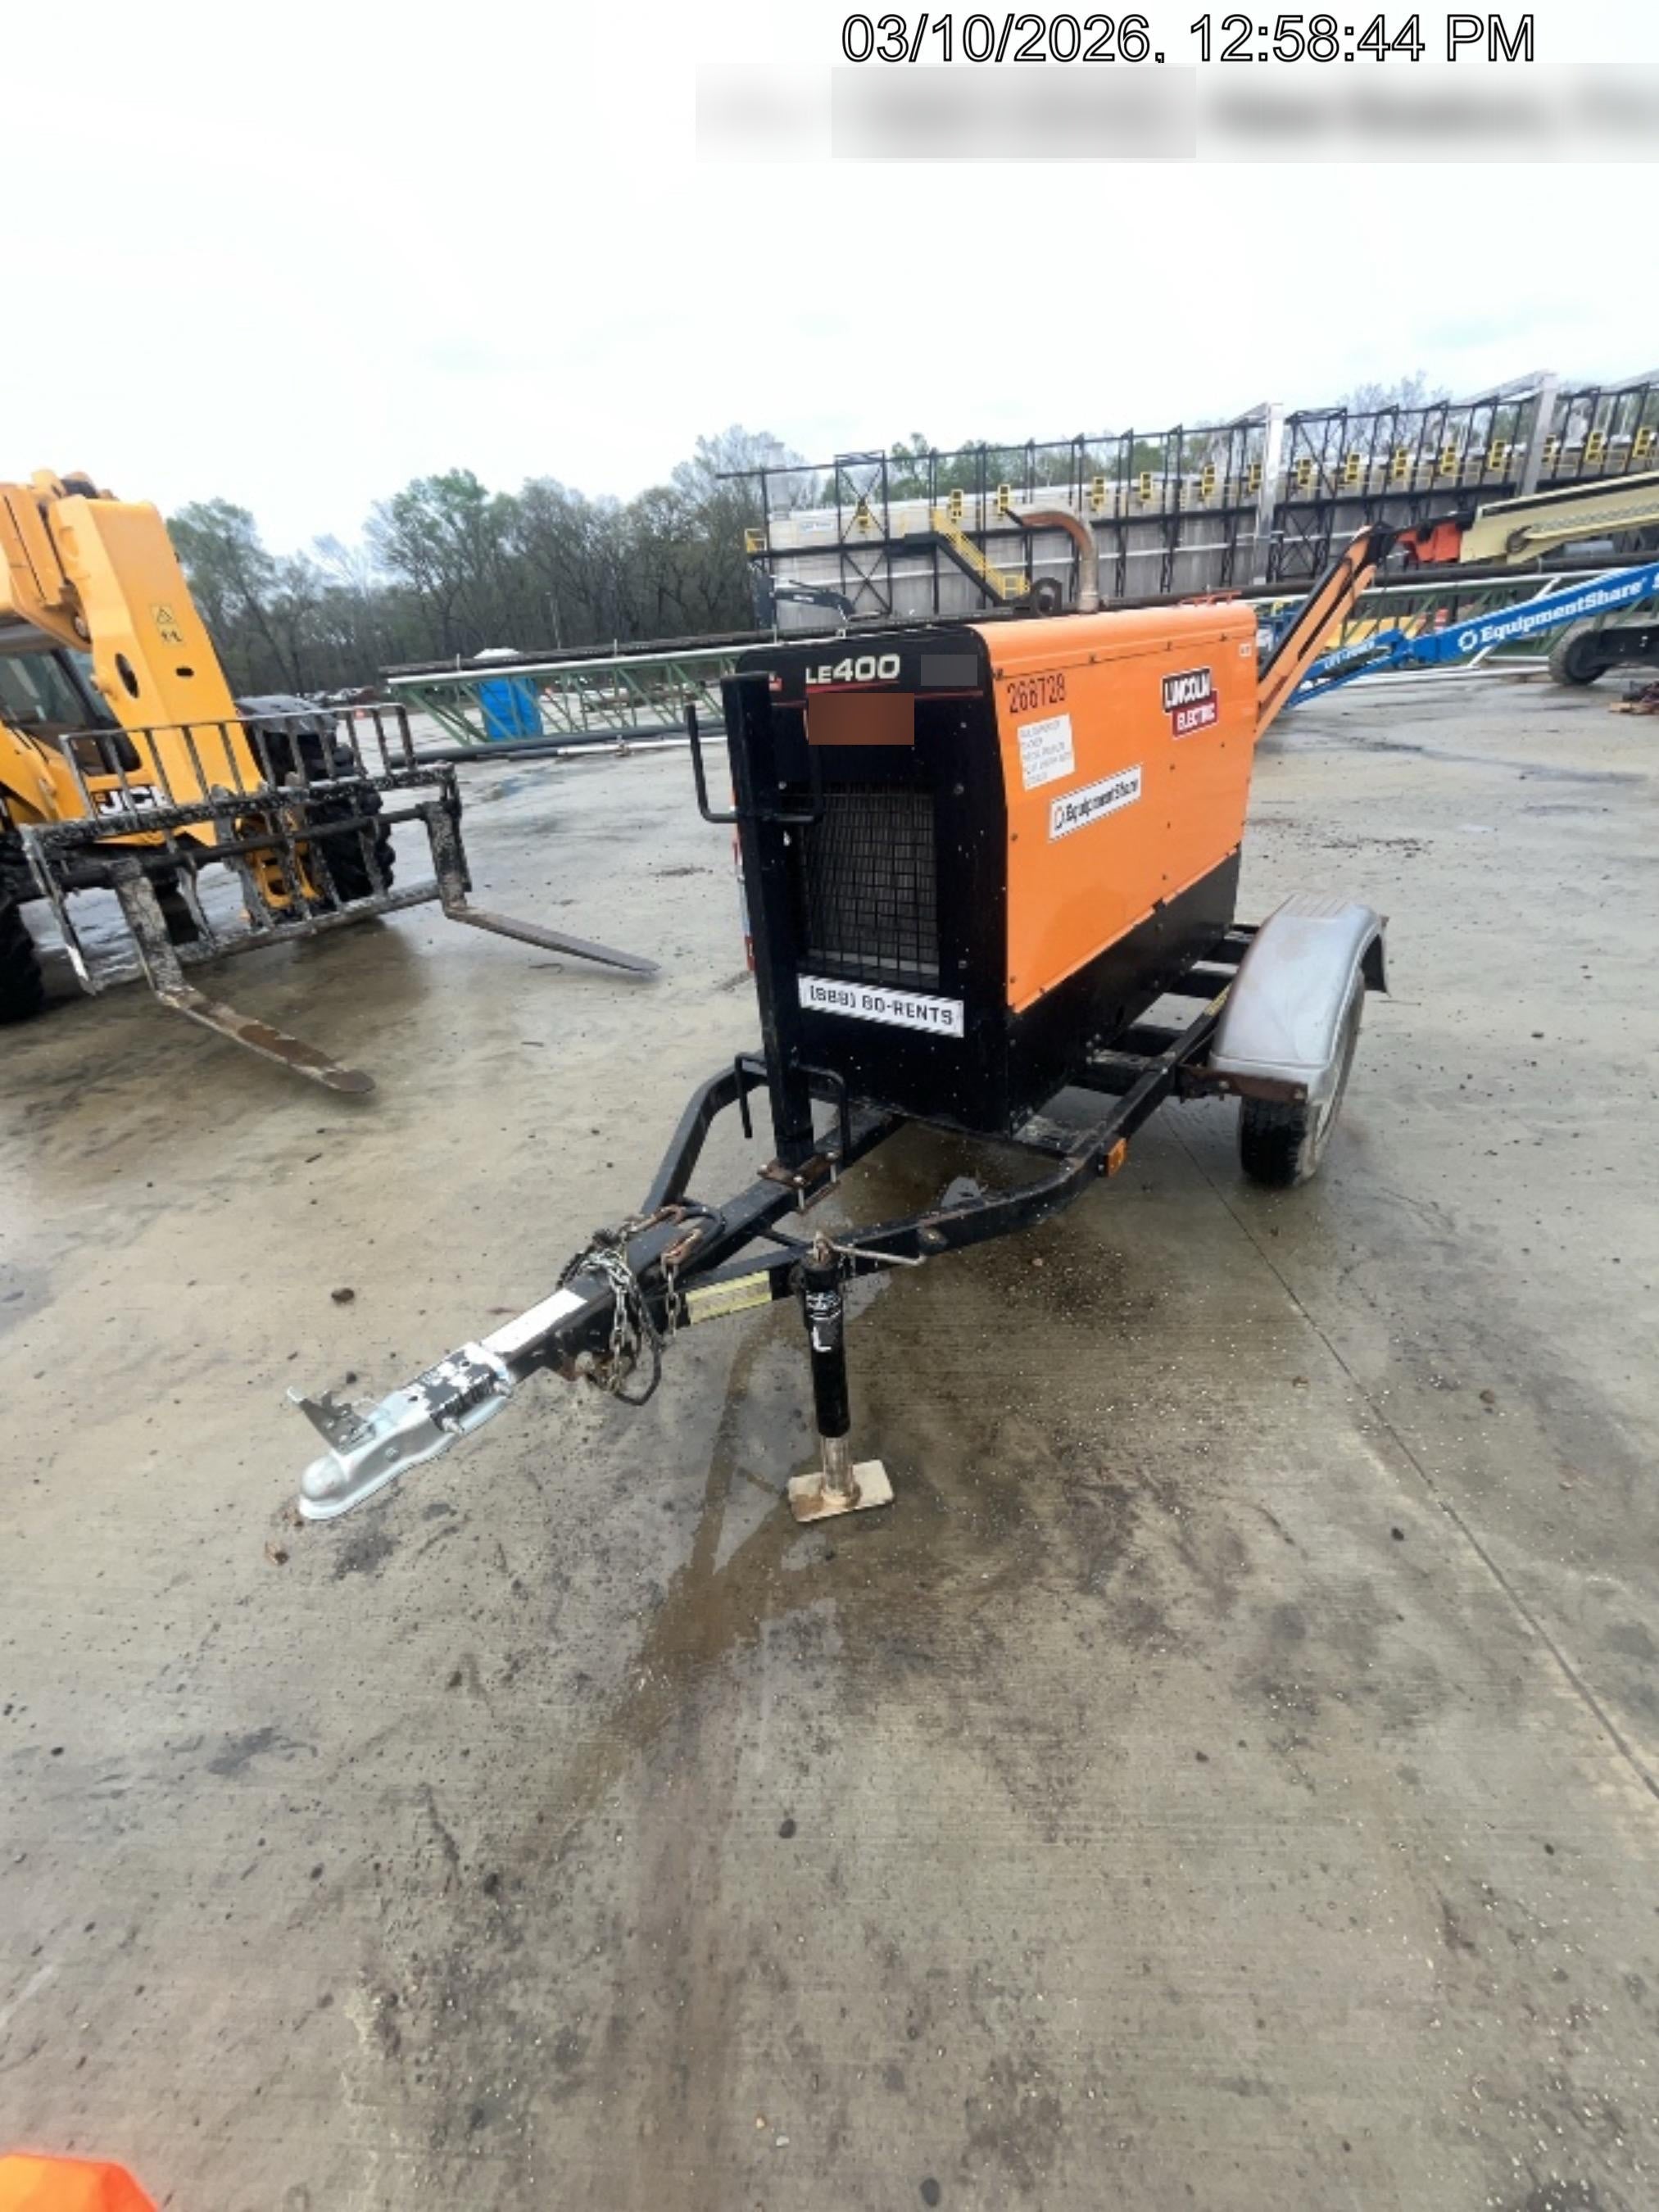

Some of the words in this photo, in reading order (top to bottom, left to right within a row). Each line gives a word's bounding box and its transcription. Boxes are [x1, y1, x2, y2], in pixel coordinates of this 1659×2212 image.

[1480, 580, 1643, 641] EquipmentShare
[805, 654, 901, 684] LE400
[1164, 672, 1210, 708] LINCOLN
